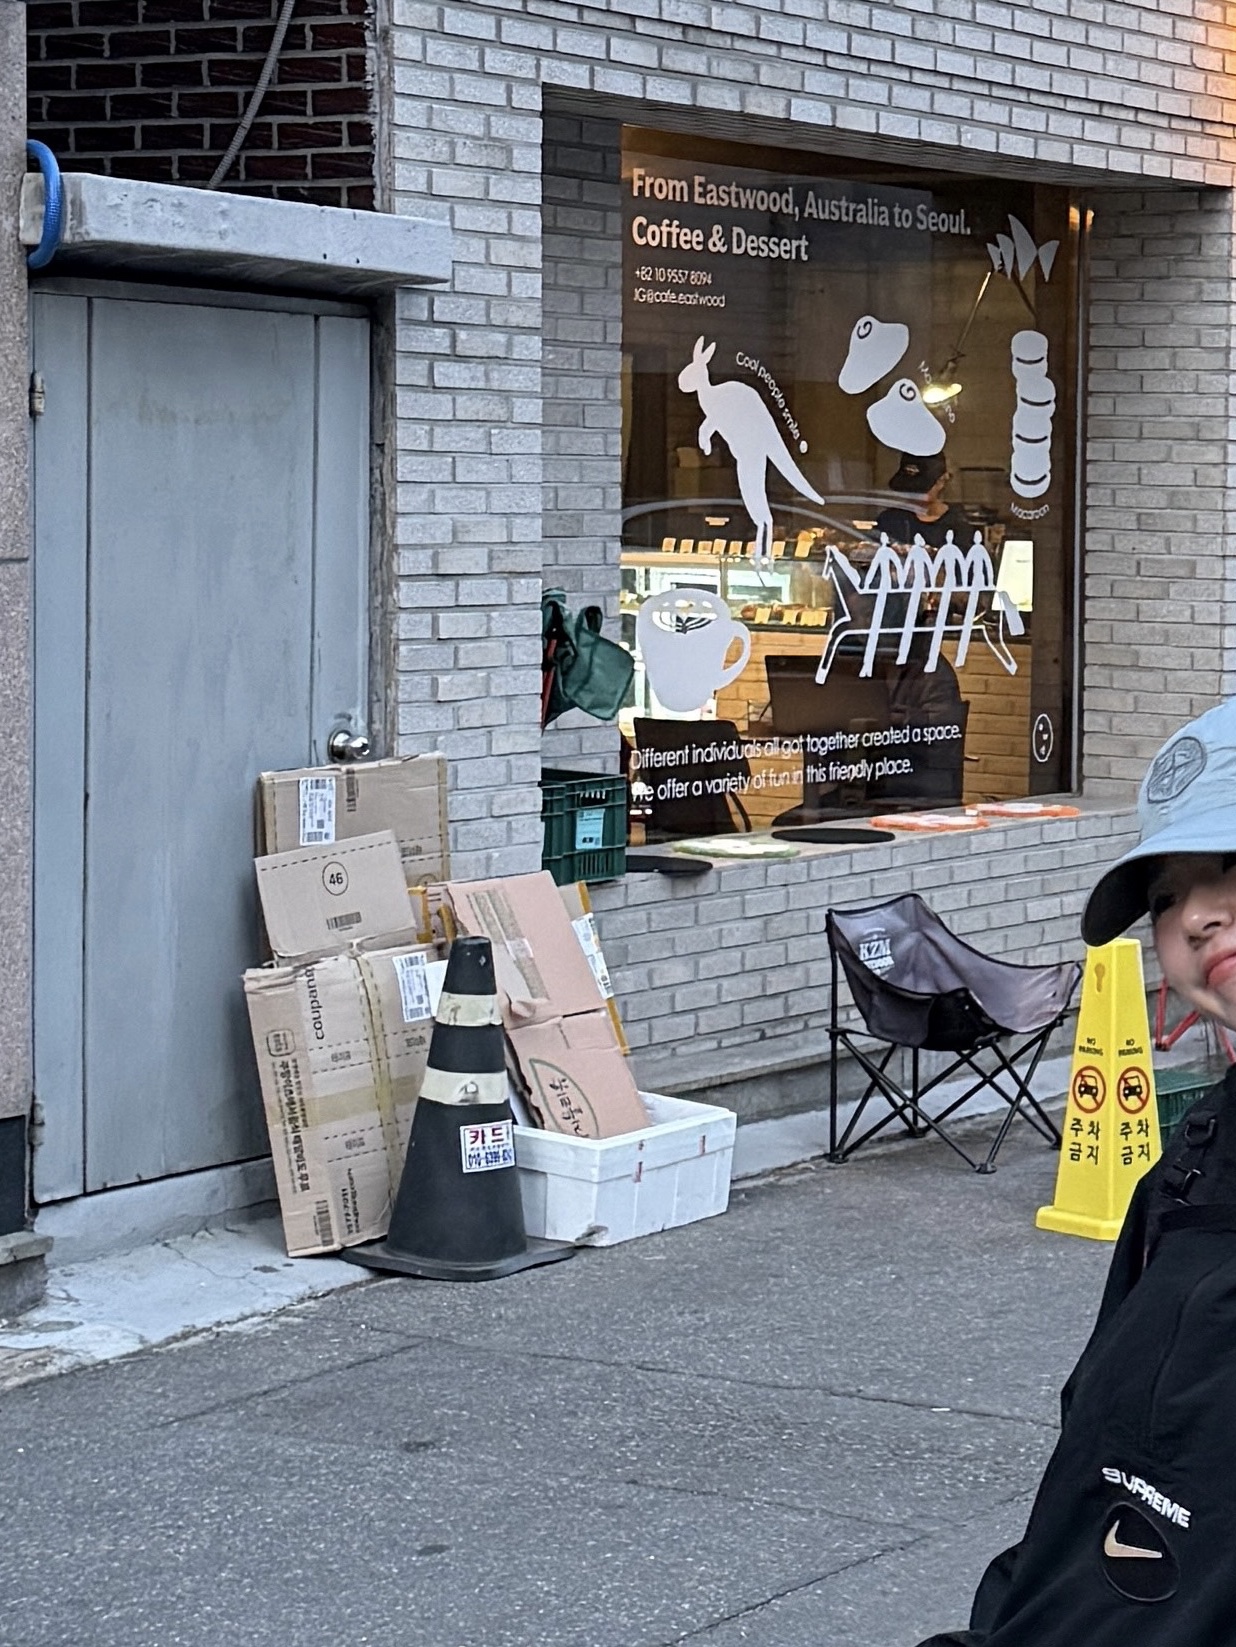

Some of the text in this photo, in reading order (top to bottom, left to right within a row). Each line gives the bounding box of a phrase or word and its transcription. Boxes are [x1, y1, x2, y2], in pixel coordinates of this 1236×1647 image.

[632, 168, 972, 235] From Eastwood, Australia to Seoul.
[631, 215, 810, 262] Coffee & Dessert
[635, 266, 653, 282] +82
[654, 267, 666, 282] 10
[735, 351, 801, 440] Cool people smile
[630, 724, 963, 770] Different individuals all got together created a space.
[657, 777, 691, 801] offer
[691, 782, 703, 797] a
[704, 771, 751, 795] variety
[752, 769, 767, 790] of
[768, 767, 790, 788] fun
[792, 766, 804, 785] in
[806, 763, 827, 784] this
[828, 758, 874, 783] friendly
[874, 756, 914, 781] place.
[329, 872, 344, 885] 46
[859, 938, 892, 961] KZM
[304, 967, 326, 1041] coupang
[469, 1127, 505, 1145] 카드
[1070, 1117, 1101, 1142] 주차
[1120, 1117, 1150, 1142] 주차
[1068, 1141, 1100, 1166] 금지
[1120, 1141, 1151, 1166] 금지
[1101, 1466, 1192, 1529] SUPREME
